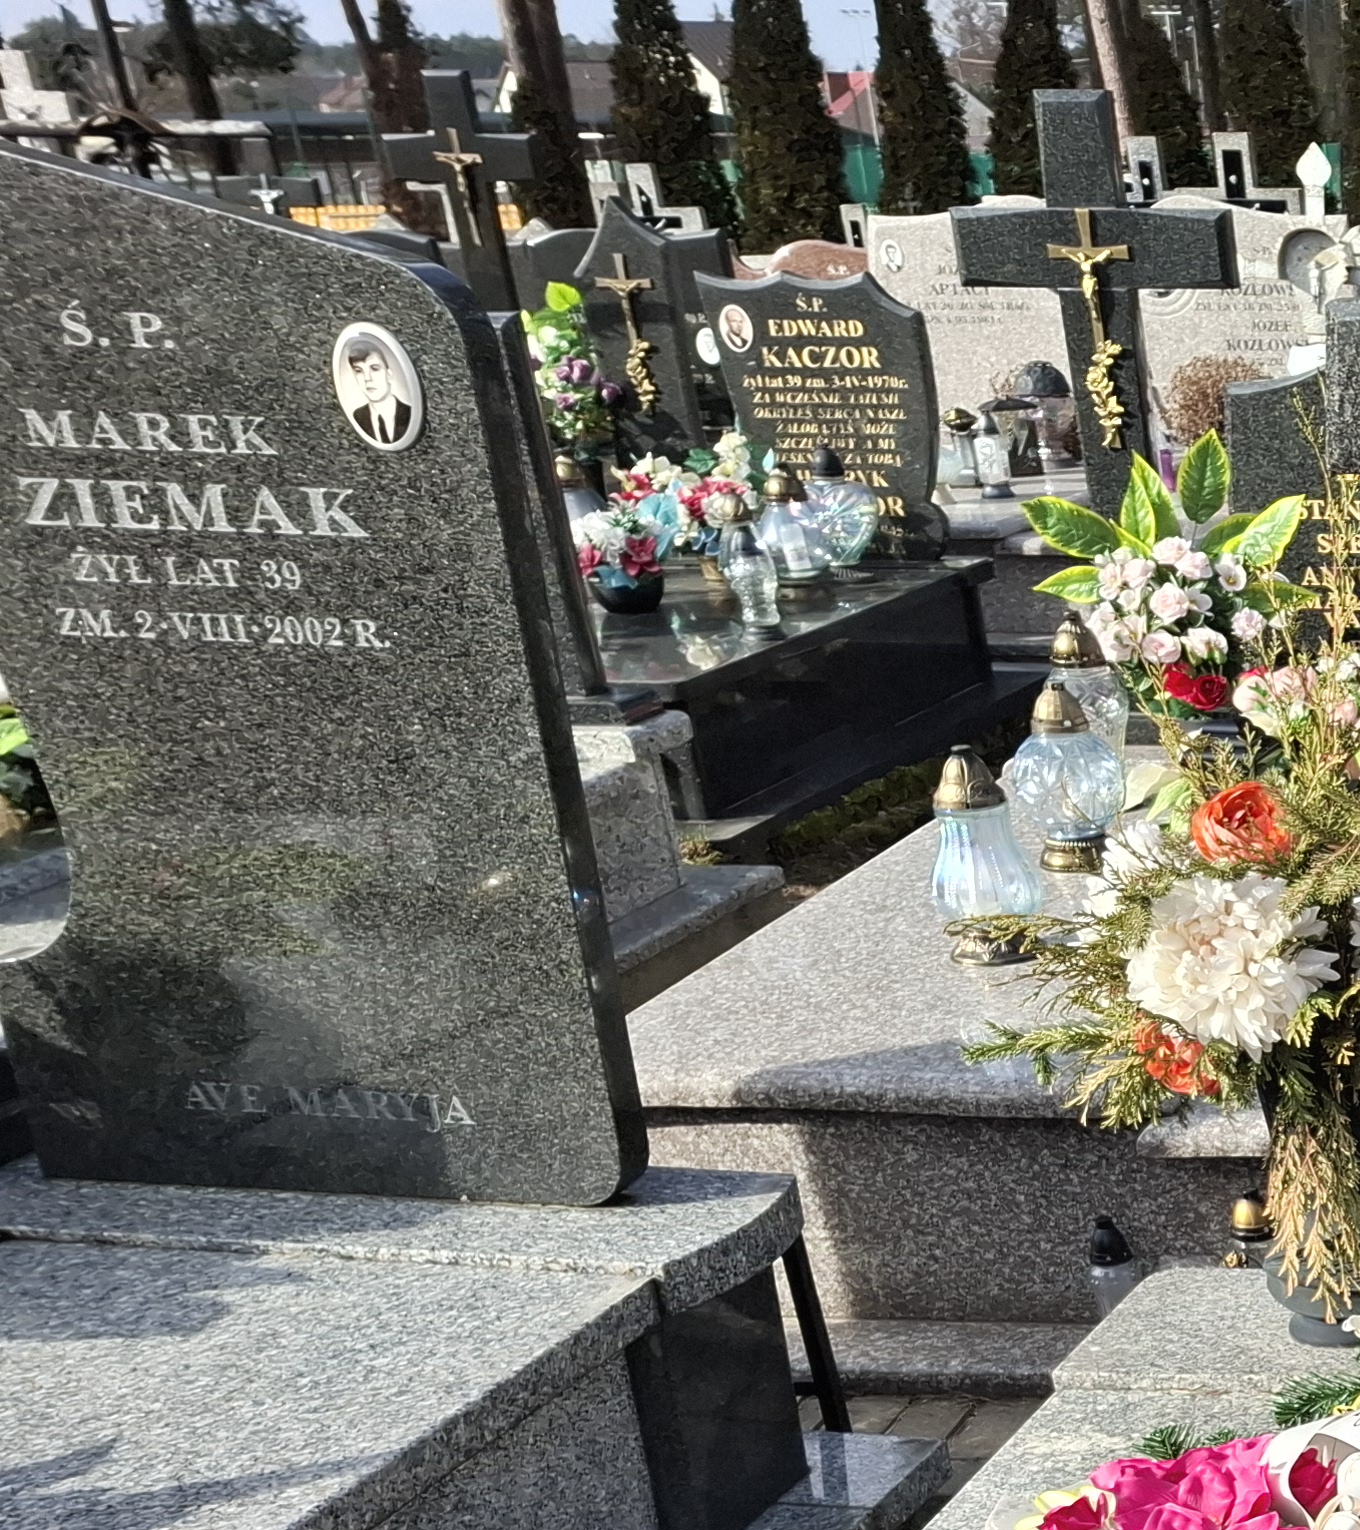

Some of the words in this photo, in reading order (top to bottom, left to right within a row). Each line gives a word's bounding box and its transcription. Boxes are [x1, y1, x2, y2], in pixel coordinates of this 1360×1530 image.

[62, 300, 110, 347] Ś.
[123, 311, 175, 349] P.
[768, 318, 865, 338] EDWARD
[760, 345, 883, 369] KACZOR
[752, 391, 771, 404] ZA
[17, 408, 279, 457] MAREK
[16, 475, 371, 538] ZIEMAK
[71, 546, 151, 585] ŻYŁ
[165, 557, 240, 589] LAT
[260, 560, 302, 591] 39
[55, 606, 127, 640] ZM.
[352, 619, 391, 650] R.
[184, 1080, 268, 1114] AVE
[281, 1084, 478, 1134] MARYJA
